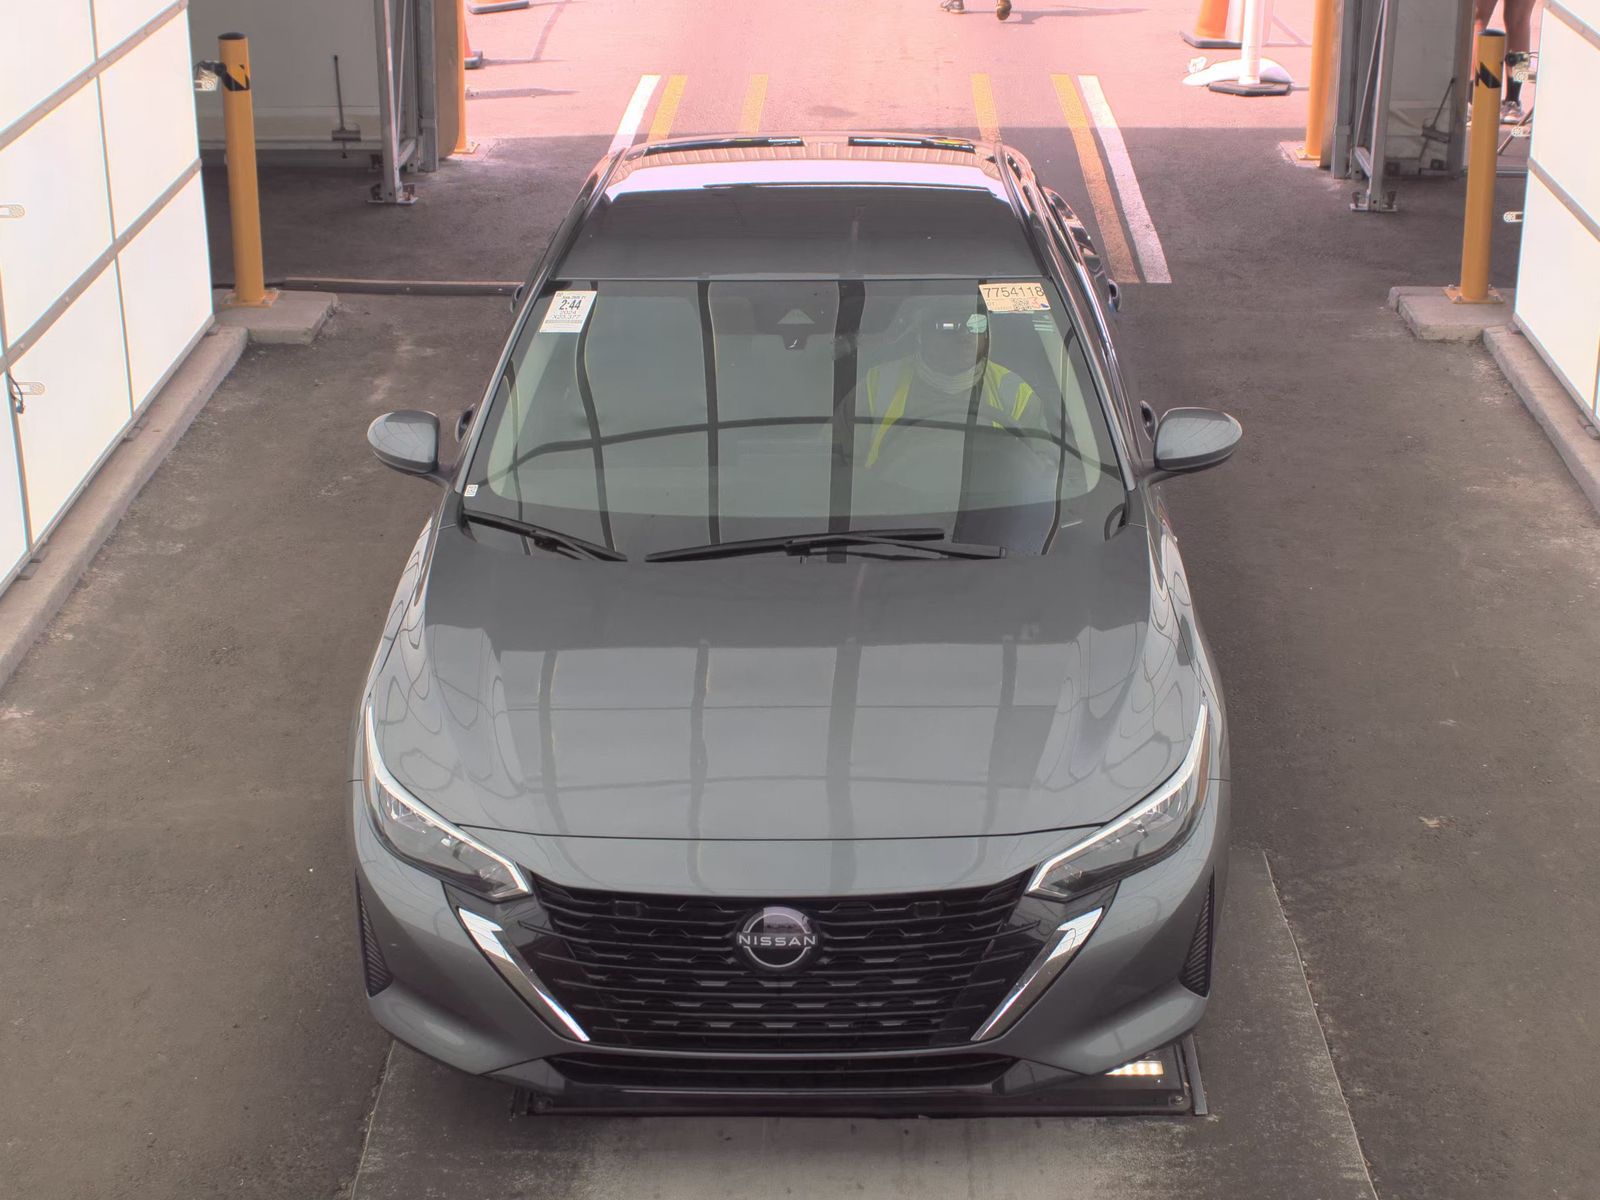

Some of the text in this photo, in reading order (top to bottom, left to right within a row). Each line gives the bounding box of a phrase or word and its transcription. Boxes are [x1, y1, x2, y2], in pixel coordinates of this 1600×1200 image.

[983, 287, 1045, 298] 7754118
[559, 299, 582, 310] 2:44
[739, 934, 816, 947] NISSAN
